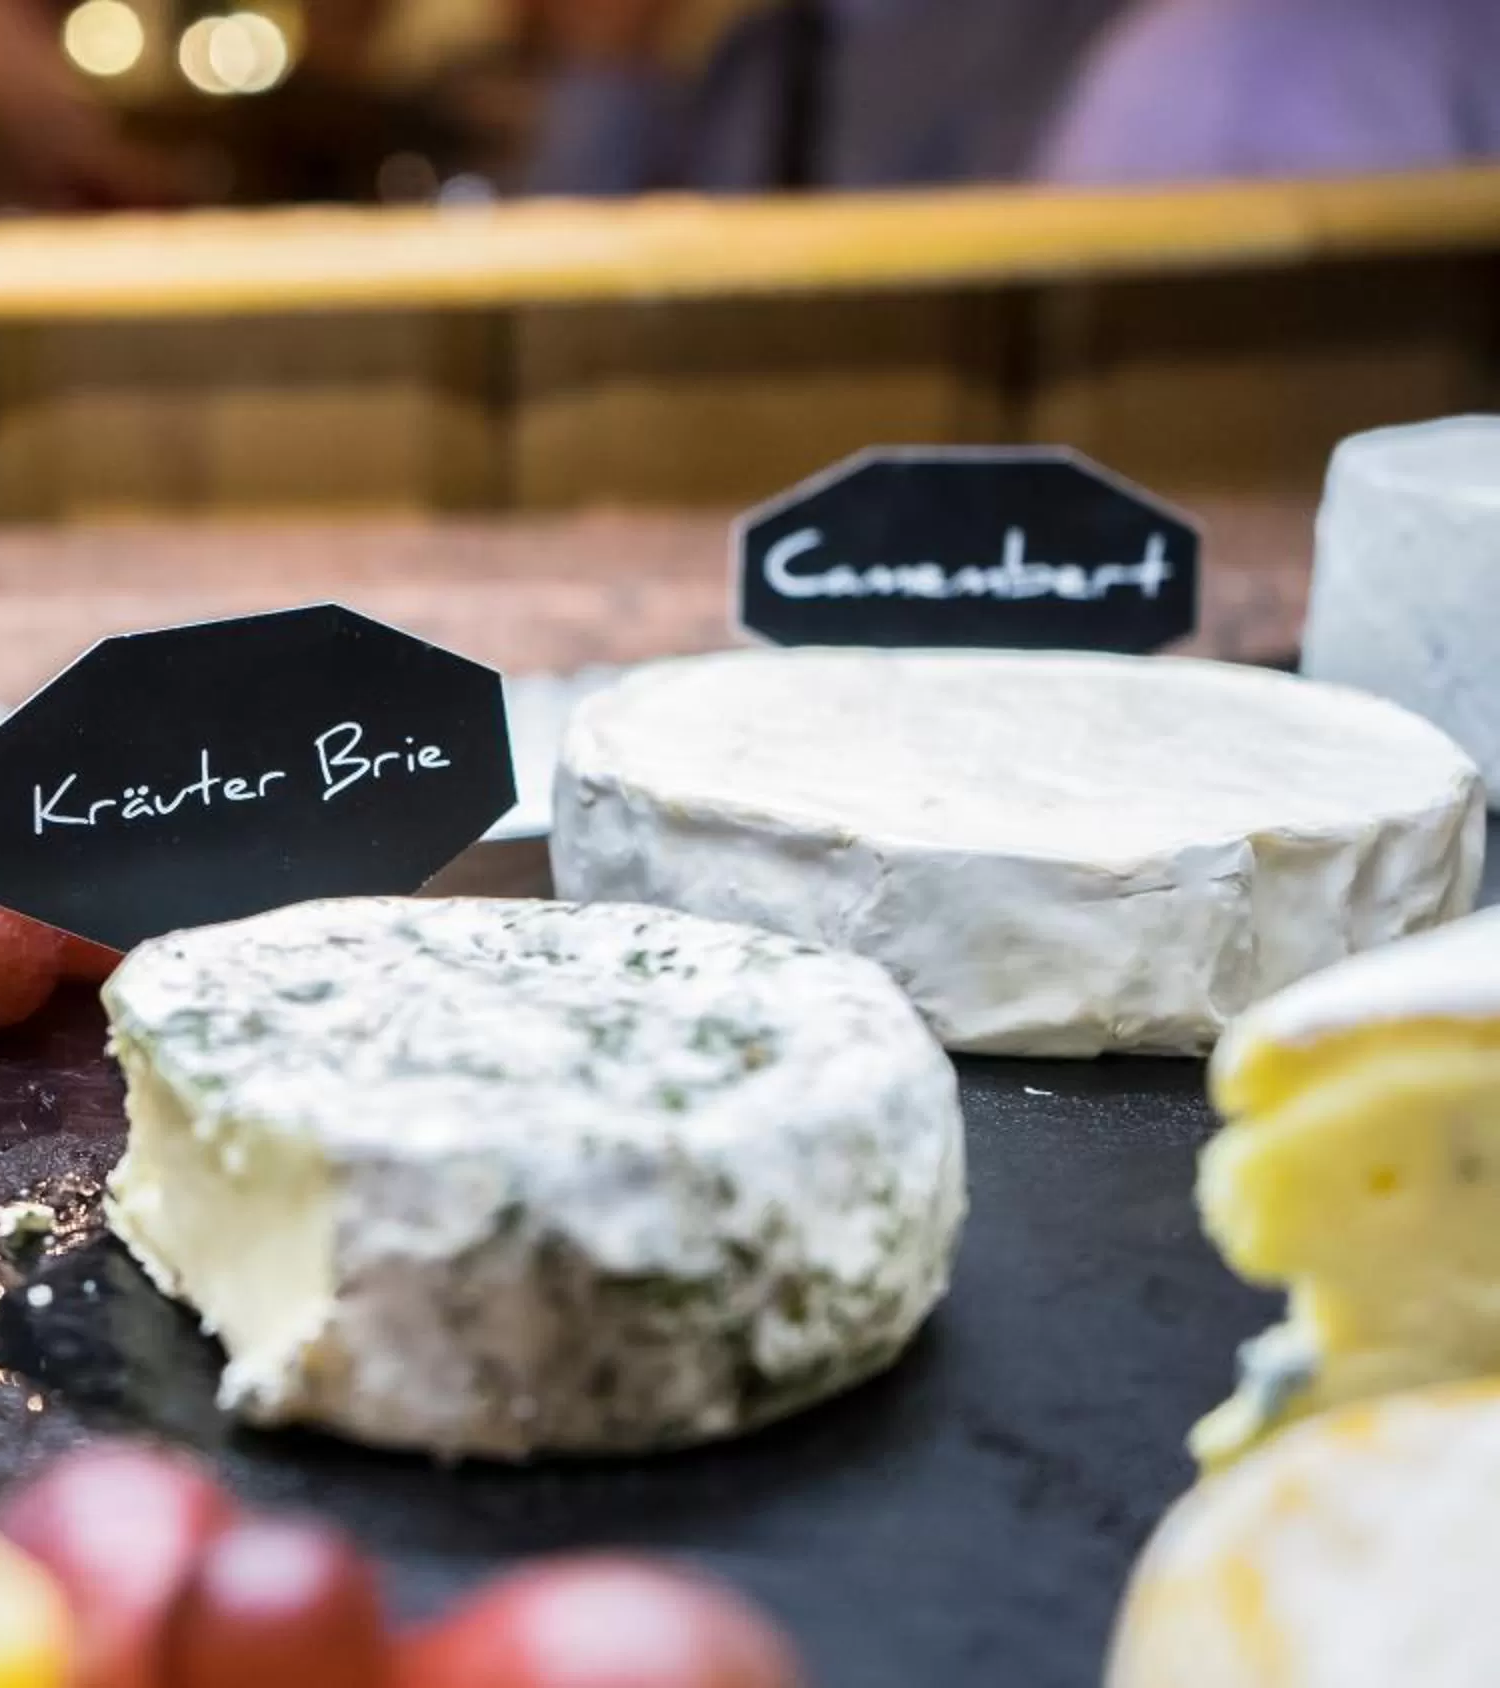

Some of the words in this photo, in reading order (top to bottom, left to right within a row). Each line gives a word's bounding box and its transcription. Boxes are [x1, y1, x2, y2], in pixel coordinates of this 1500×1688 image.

[763, 526, 1173, 600] Camembert
[32, 748, 287, 836] Kräuter
[313, 720, 452, 802] Brie
